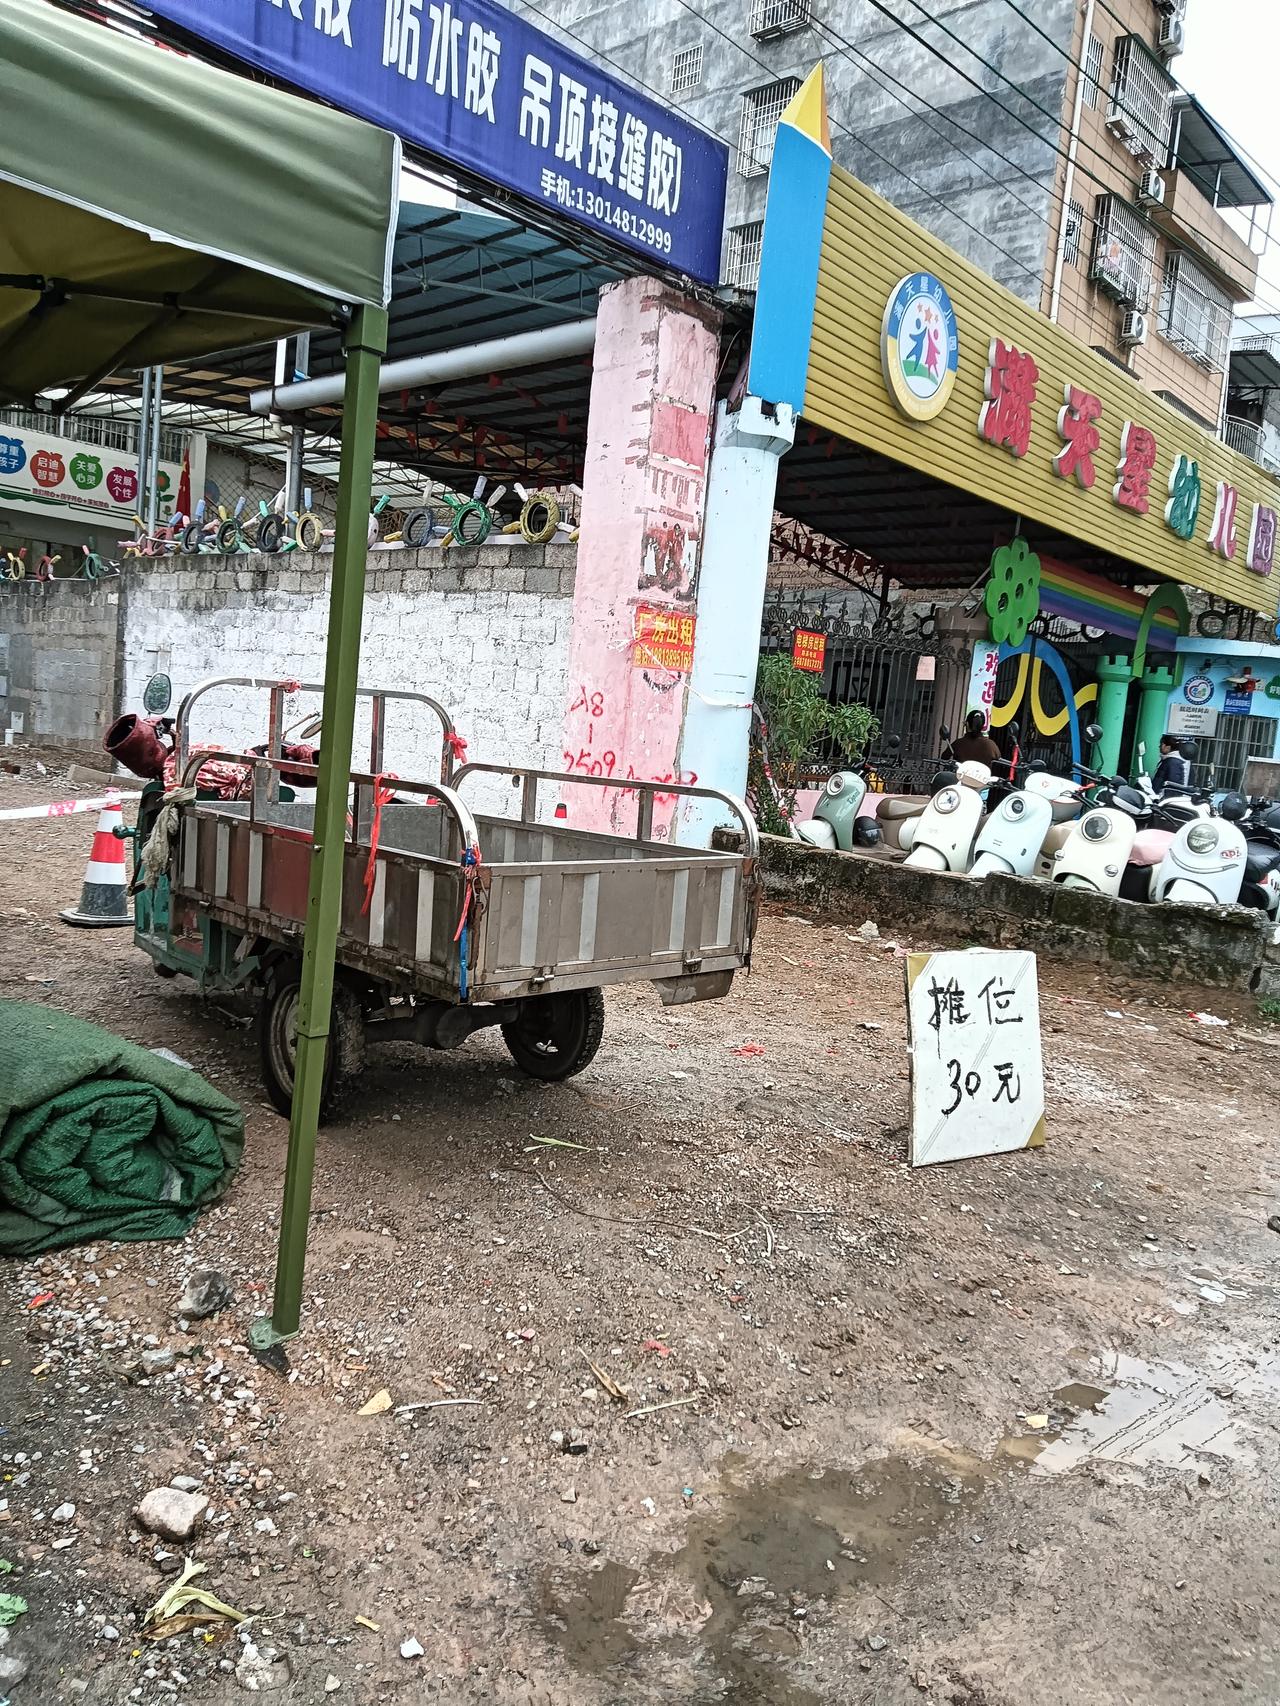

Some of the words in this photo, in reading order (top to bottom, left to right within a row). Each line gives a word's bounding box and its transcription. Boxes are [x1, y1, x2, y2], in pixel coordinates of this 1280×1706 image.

[382, 0, 501, 124] 防水胶
[76, 472, 96, 486] 心灵
[113, 474, 133, 487] 发展
[112, 486, 133, 499] 个性
[635, 612, 693, 646] 厂房出租
[941, 1058, 1021, 1116] 30元
